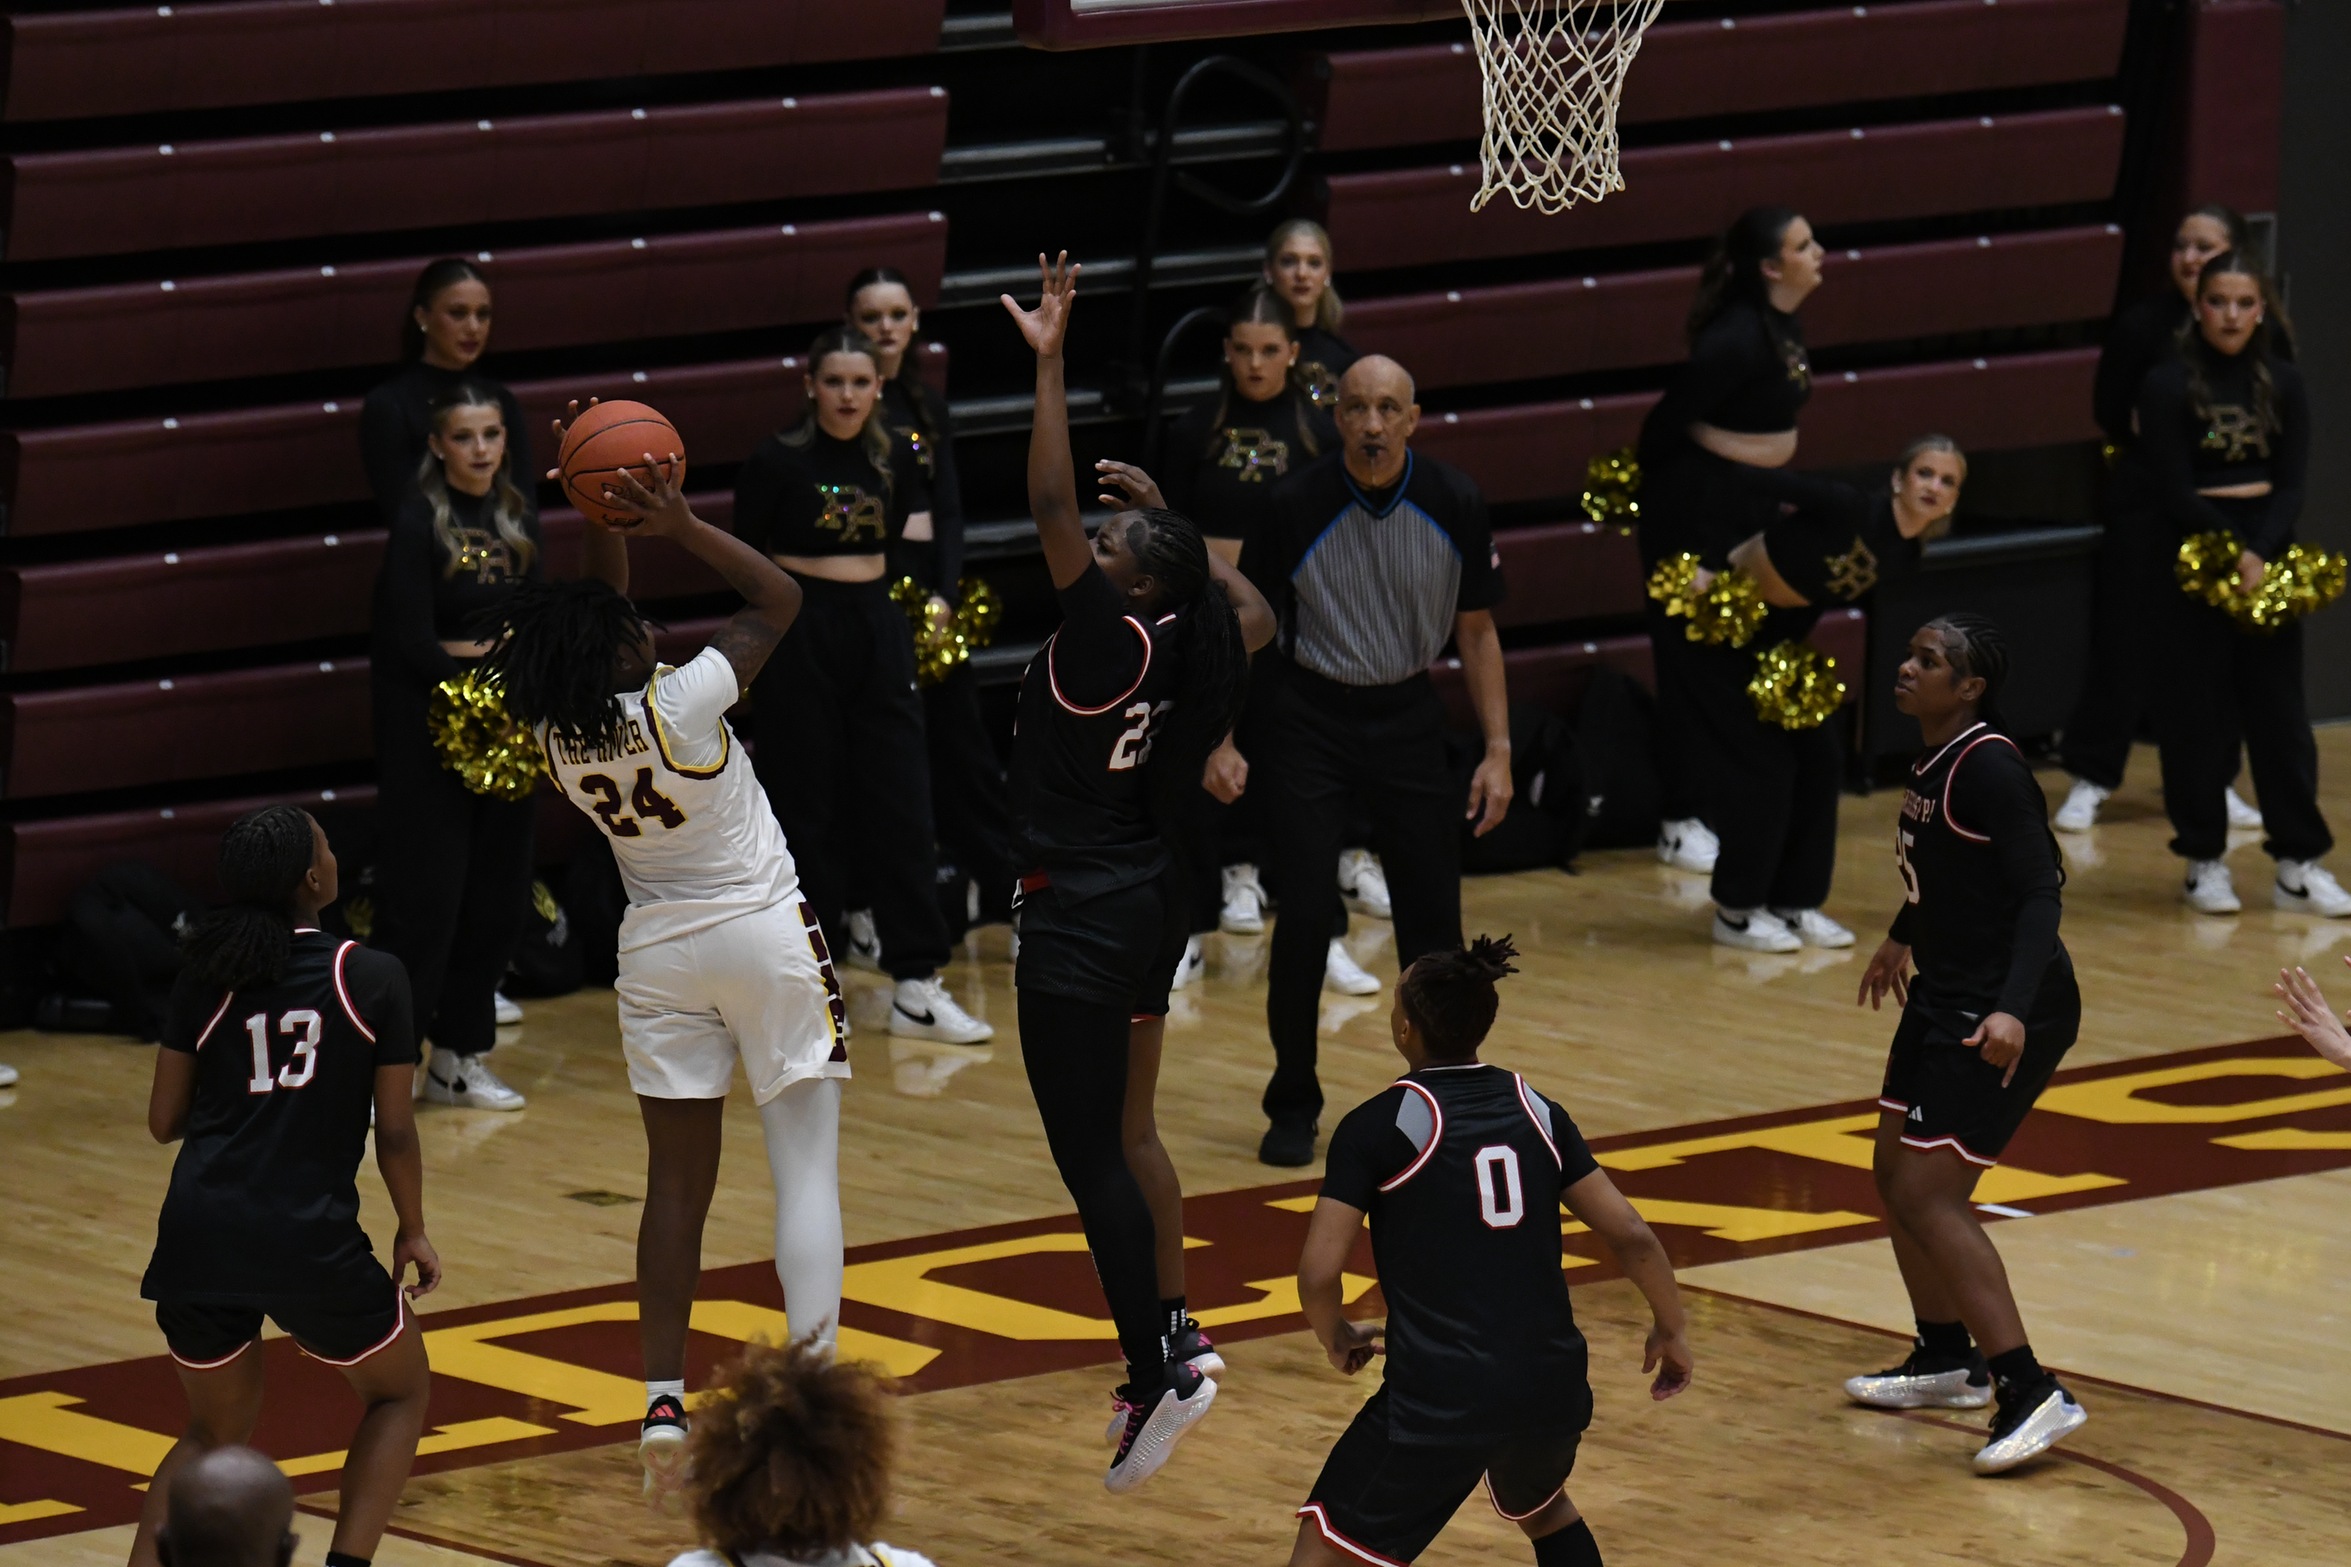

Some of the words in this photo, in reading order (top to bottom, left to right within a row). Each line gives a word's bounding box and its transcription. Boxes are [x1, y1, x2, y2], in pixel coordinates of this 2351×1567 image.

[579, 766, 688, 837] 24
[1896, 826, 1921, 906] 5
[243, 1006, 325, 1096] 13
[1472, 1143, 1527, 1231] 0
